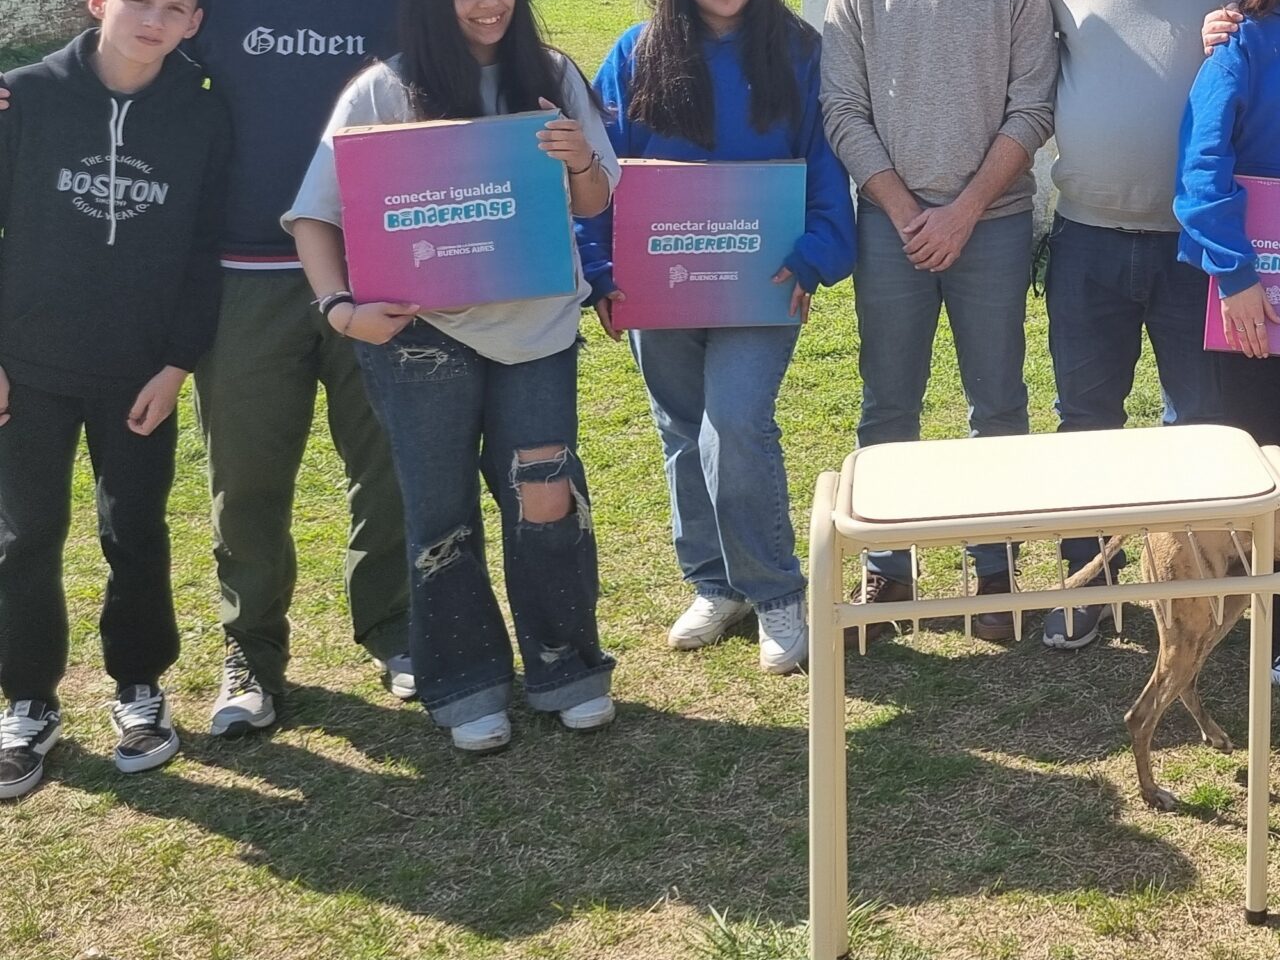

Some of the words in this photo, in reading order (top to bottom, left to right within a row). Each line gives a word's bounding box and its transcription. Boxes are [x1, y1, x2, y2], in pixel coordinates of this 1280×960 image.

[242, 26, 366, 55] Golden
[81, 155, 102, 166] THE
[57, 168, 169, 205] BOSTON
[385, 190, 447, 205] conectar
[450, 181, 511, 201] igualdad
[72, 196, 103, 218] CASUAL
[651, 220, 705, 231] conectar
[707, 219, 759, 233] igualdad
[437, 247, 471, 258] BUENOS
[472, 244, 495, 253] AIRES
